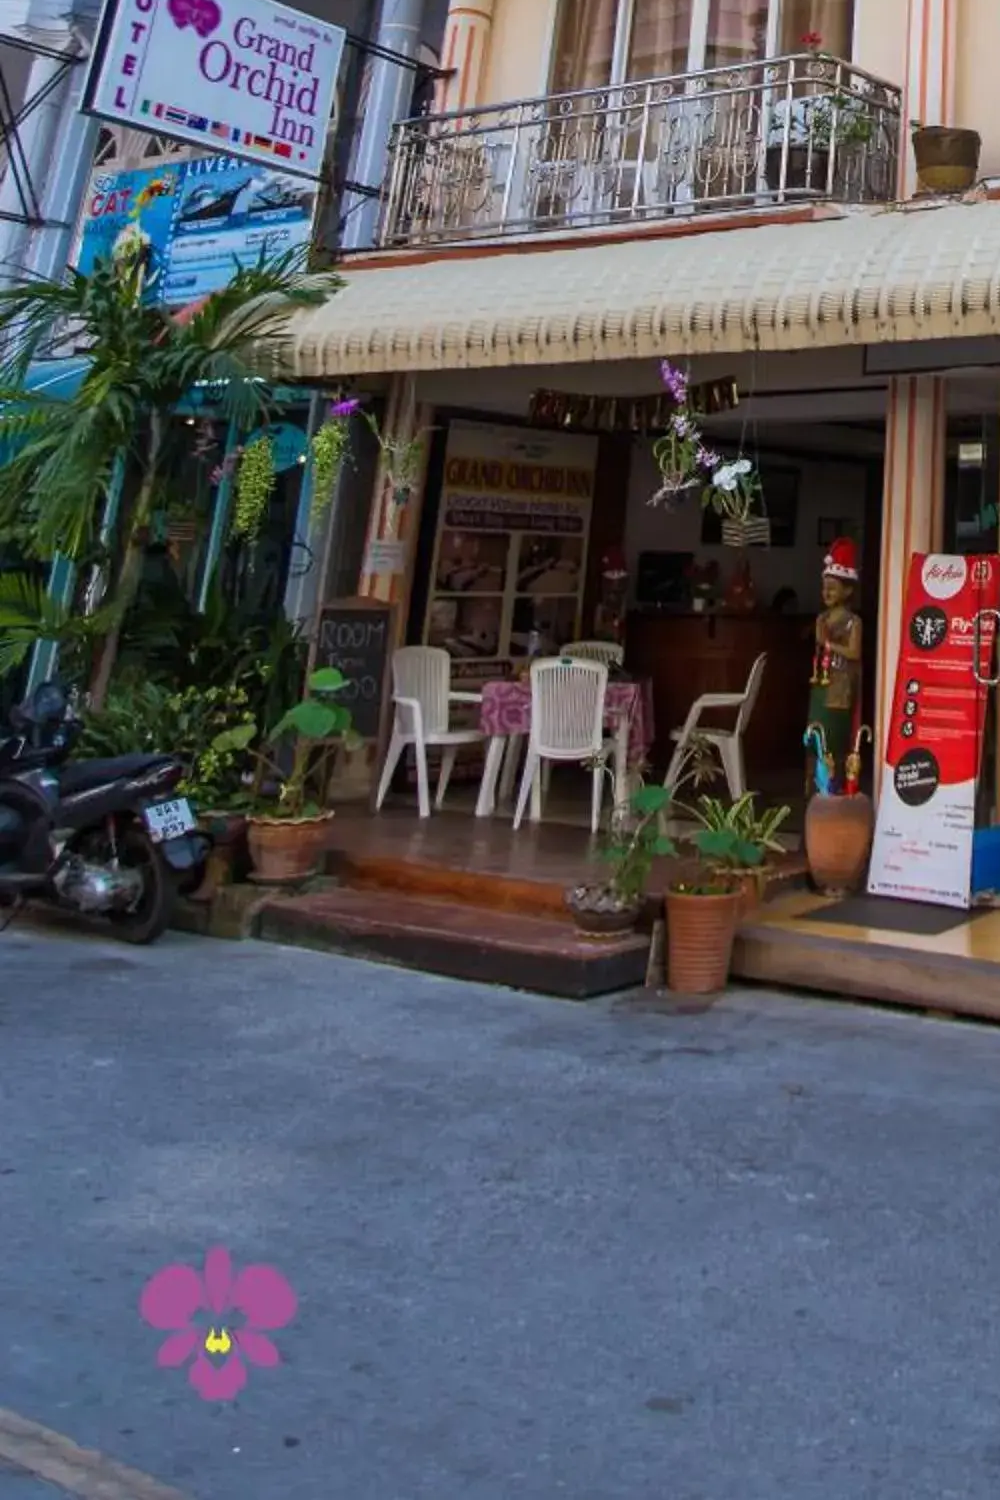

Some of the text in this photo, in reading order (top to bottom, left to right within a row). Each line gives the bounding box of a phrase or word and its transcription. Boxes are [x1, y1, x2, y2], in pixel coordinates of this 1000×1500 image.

[233, 17, 316, 73] Grand
[199, 40, 321, 117] Orchid
[268, 105, 315, 147] Inn
[91, 189, 132, 217] CAT
[319, 620, 386, 649] ROOM
